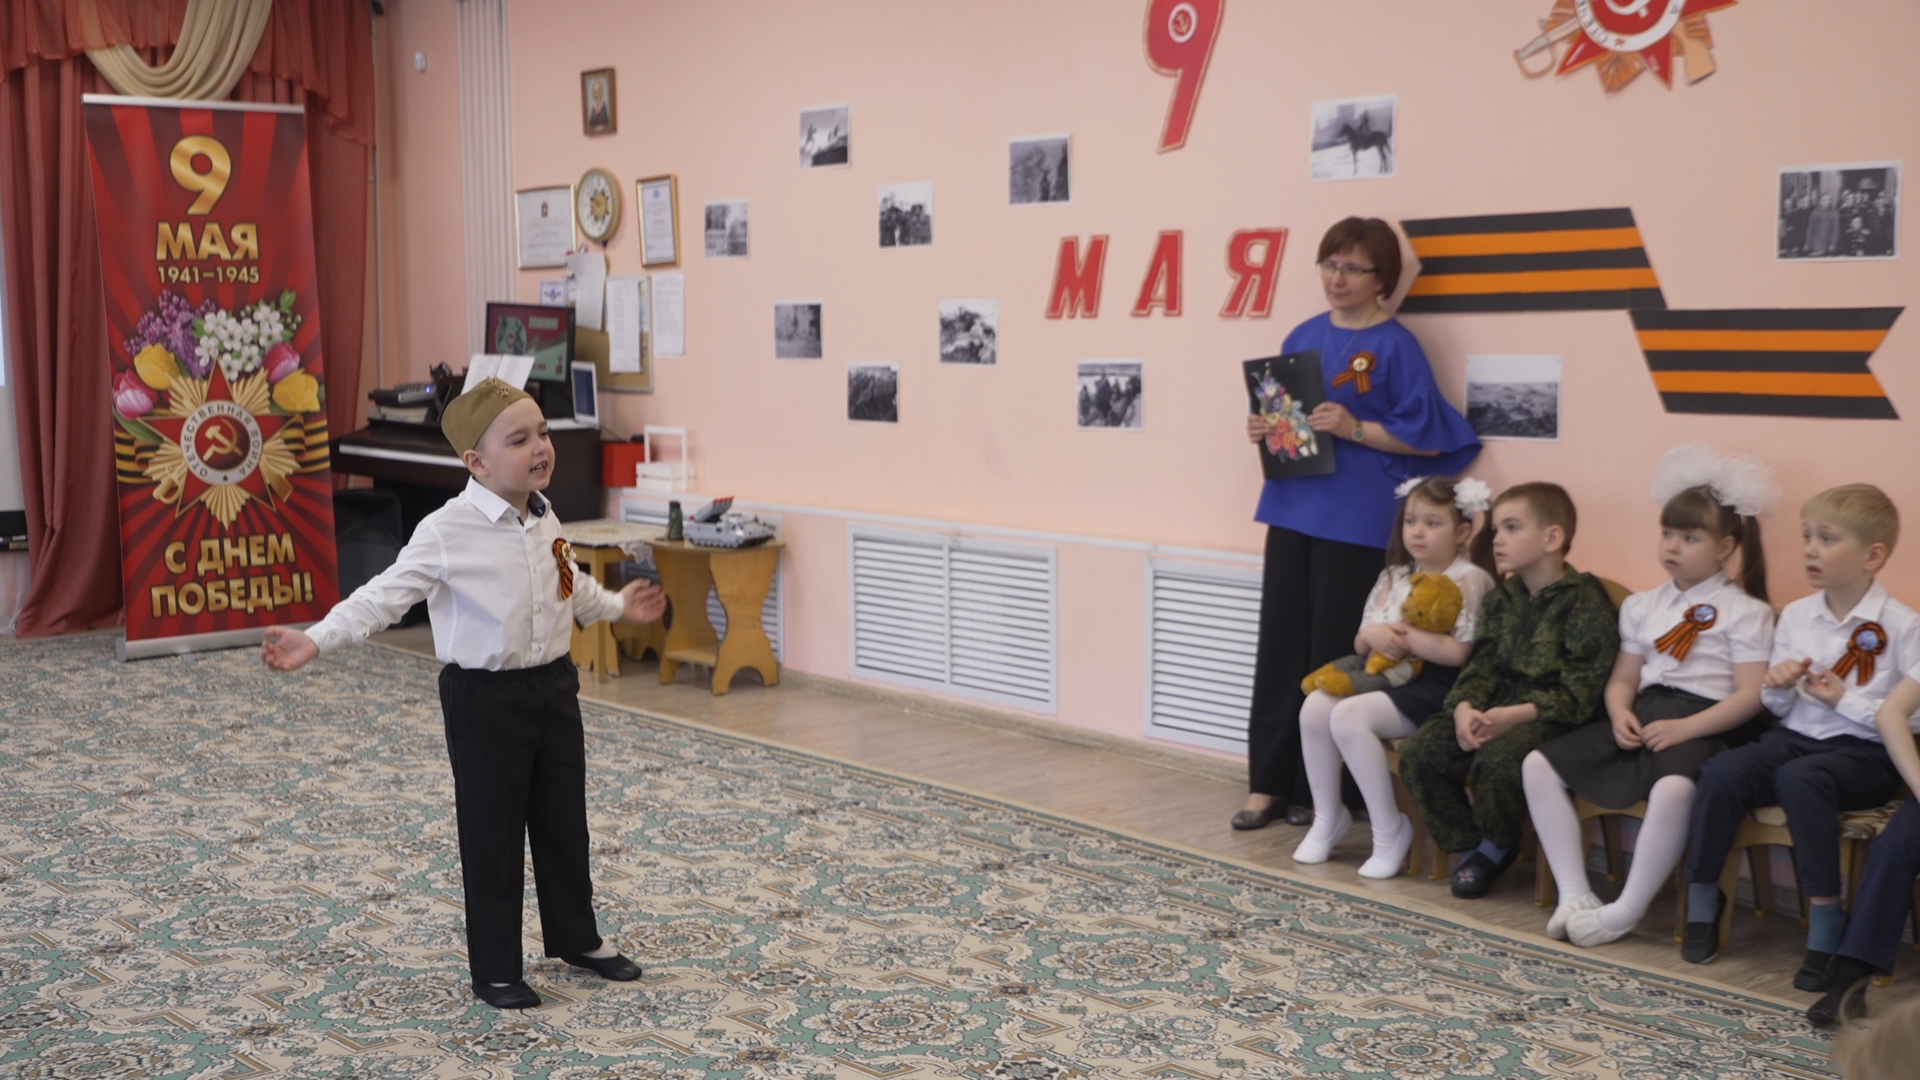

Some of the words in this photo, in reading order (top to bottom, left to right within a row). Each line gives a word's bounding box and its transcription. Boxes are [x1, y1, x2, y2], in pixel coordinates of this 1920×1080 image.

[1142, 0, 1226, 154] 9
[170, 134, 232, 215] 9
[156, 222, 259, 261] МАЯ
[1044, 227, 1289, 320] МАЯ
[184, 403, 252, 478] ОТЕЧЕСТВЕННАЯ
[164, 540, 187, 575] С
[197, 532, 296, 577] ДНЕМ
[151, 571, 314, 618] ПОБЕДЫ!
